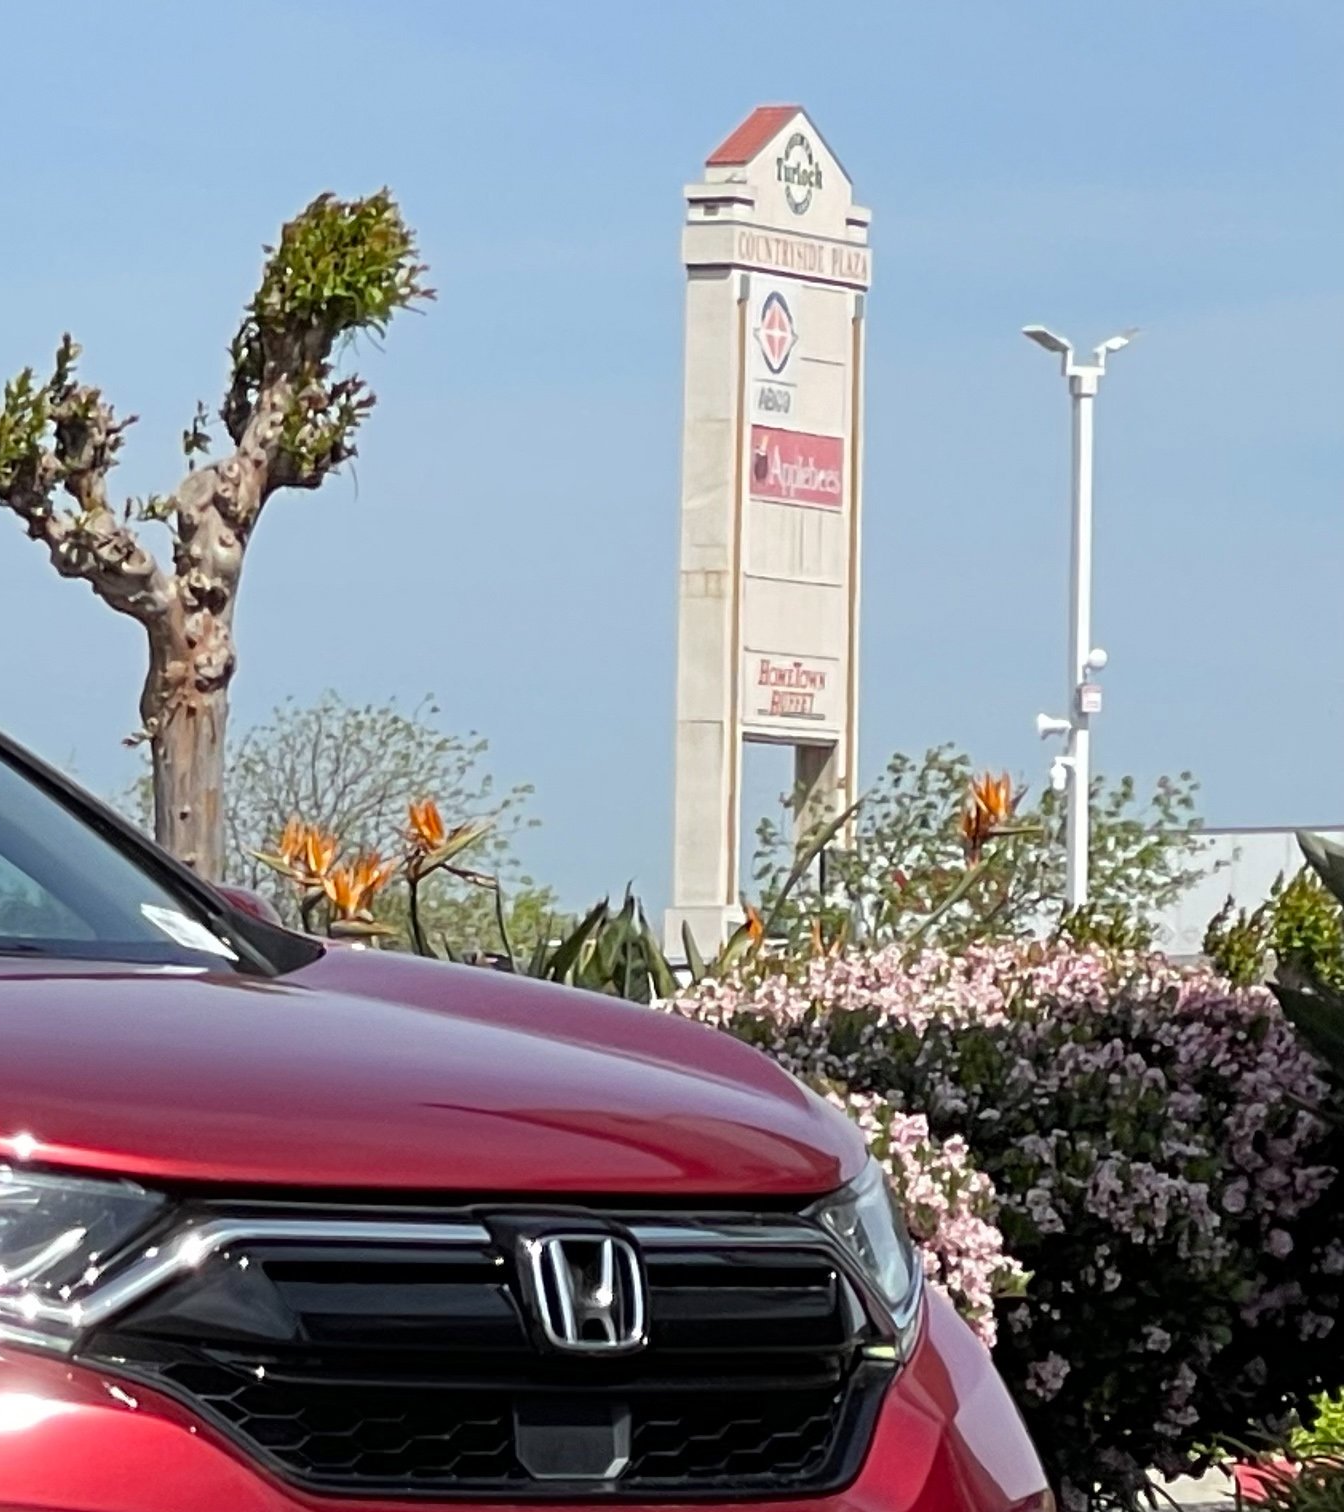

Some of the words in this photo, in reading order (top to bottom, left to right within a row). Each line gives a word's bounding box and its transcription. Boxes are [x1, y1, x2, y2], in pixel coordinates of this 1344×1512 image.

[776, 157, 823, 190] Turlock
[737, 231, 824, 273] COUNTRYSIDE
[831, 247, 868, 282] PLAZA
